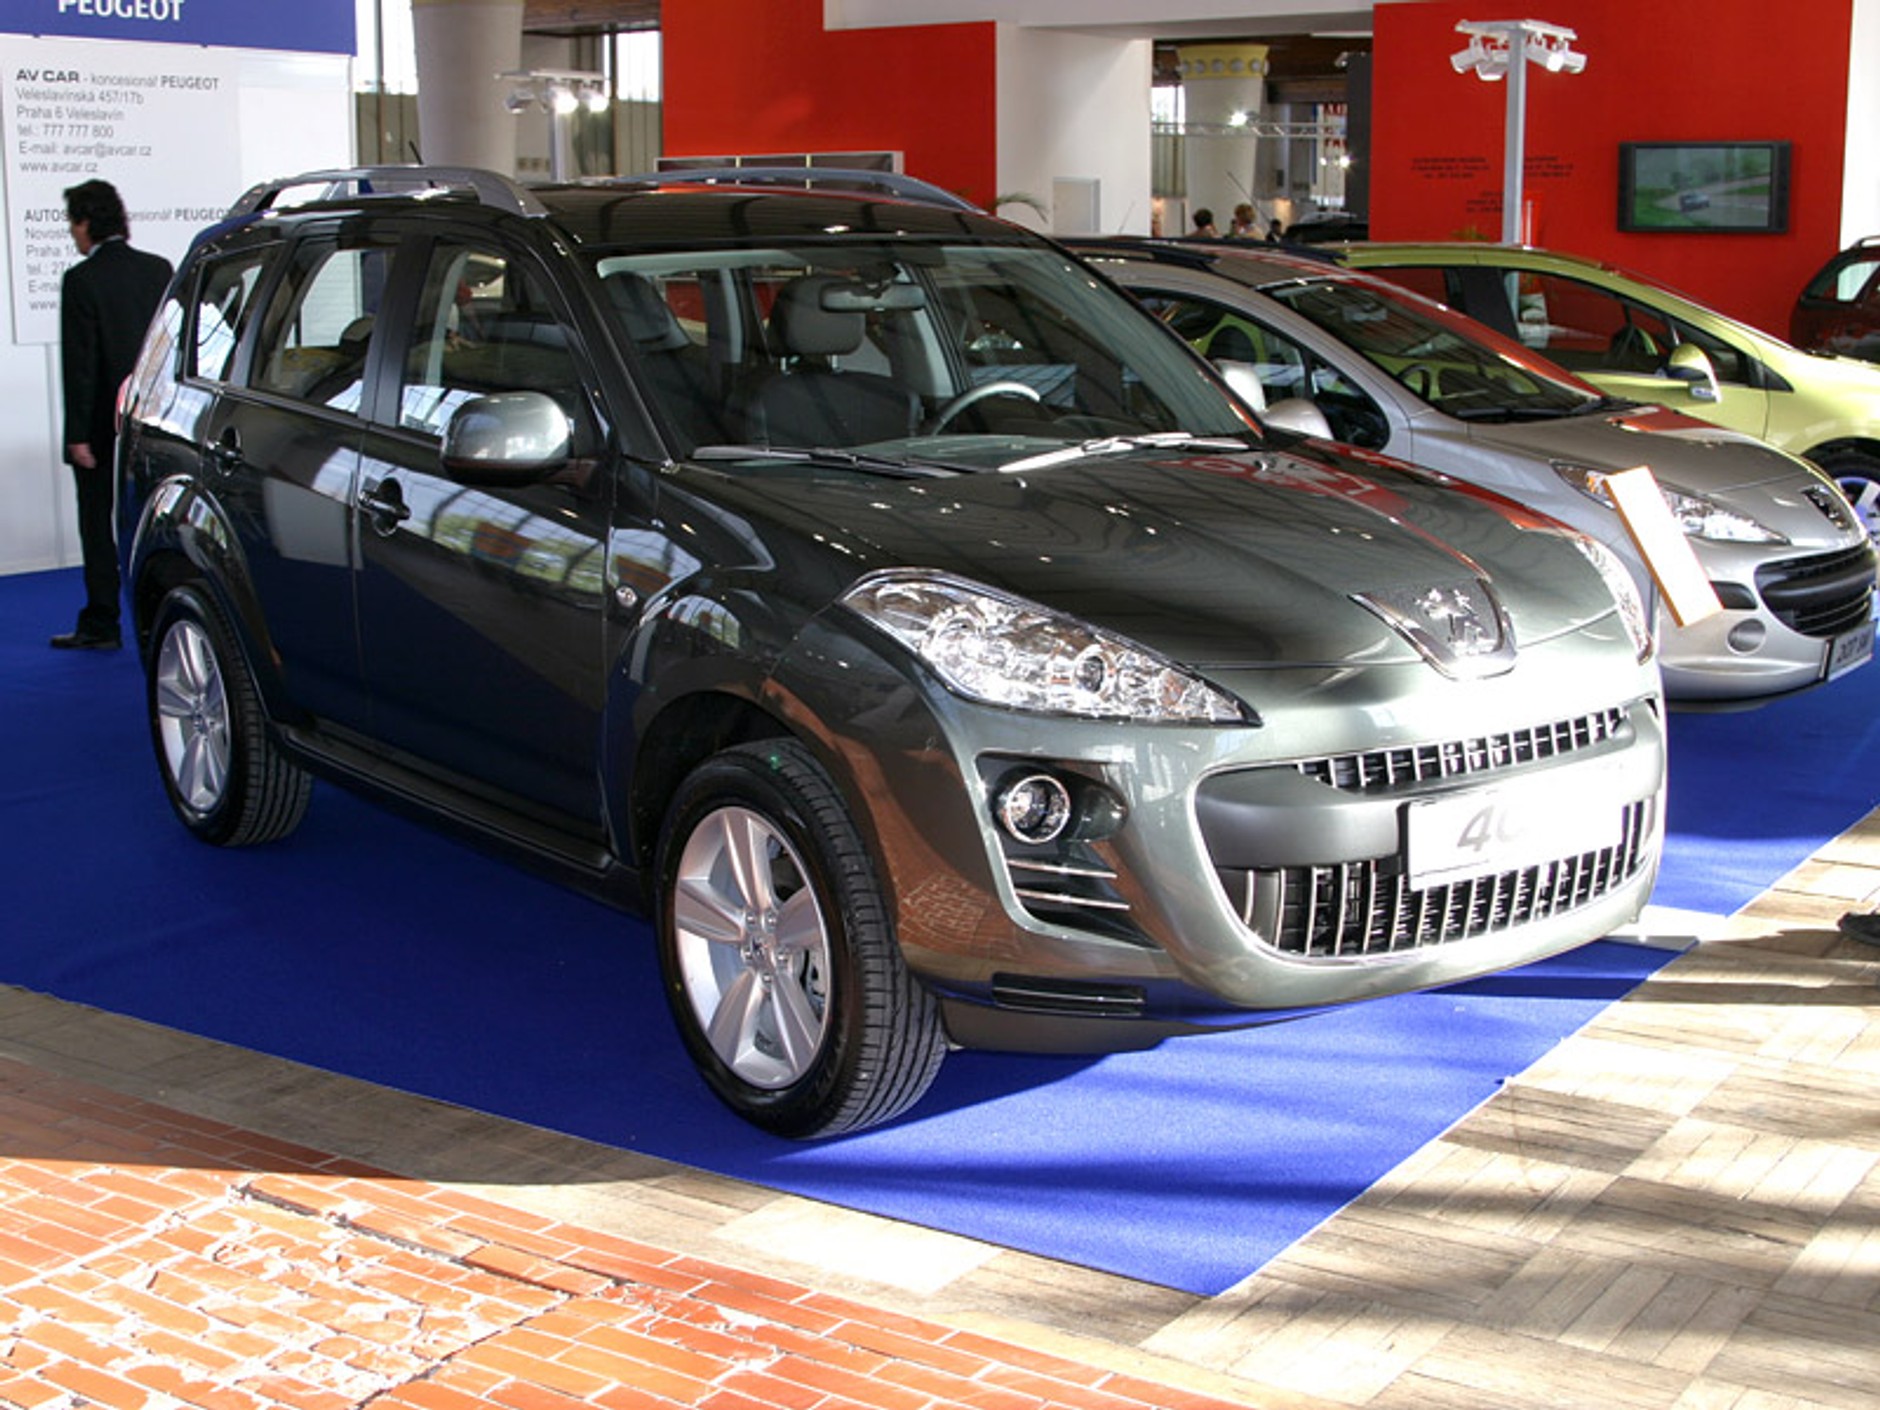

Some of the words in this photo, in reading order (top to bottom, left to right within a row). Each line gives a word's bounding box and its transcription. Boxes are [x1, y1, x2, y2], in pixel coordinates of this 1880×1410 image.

[58, 0, 184, 20] PEUGEOT
[16, 69, 39, 82] AV
[42, 70, 80, 83] CAR
[160, 75, 219, 90] PEUGEOT
[17, 104, 52, 119] Praha
[43, 124, 64, 137] 777
[68, 124, 89, 138] 777
[26, 244, 60, 258] Praha
